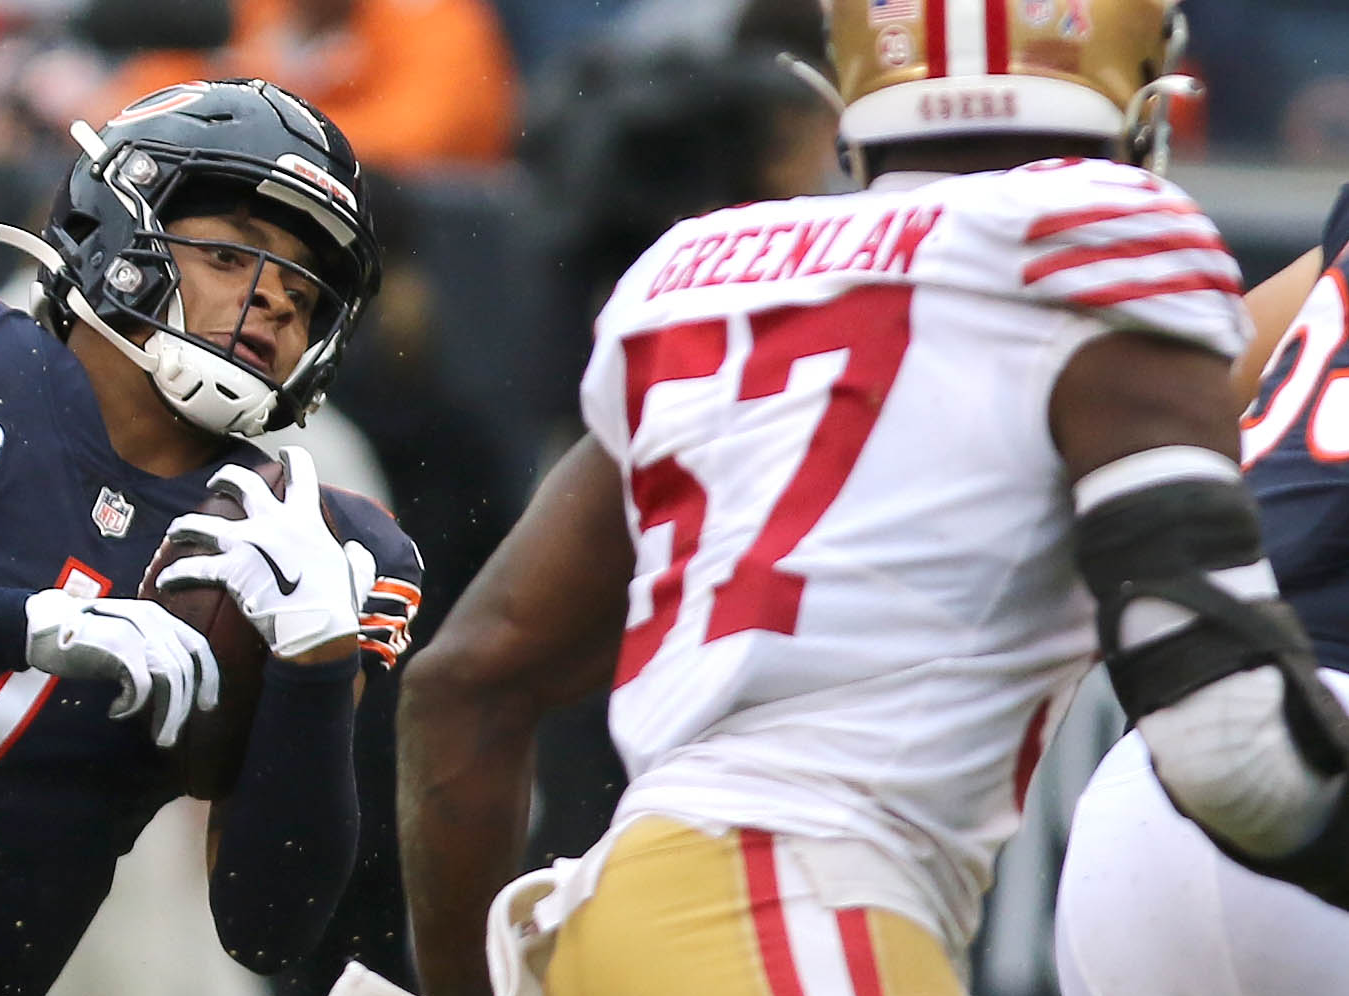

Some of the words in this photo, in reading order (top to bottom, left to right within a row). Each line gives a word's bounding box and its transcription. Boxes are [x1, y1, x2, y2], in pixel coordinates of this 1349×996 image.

[918, 91, 1017, 119] 49ERS
[646, 205, 944, 301] GREENLAW
[612, 285, 913, 692] 57
